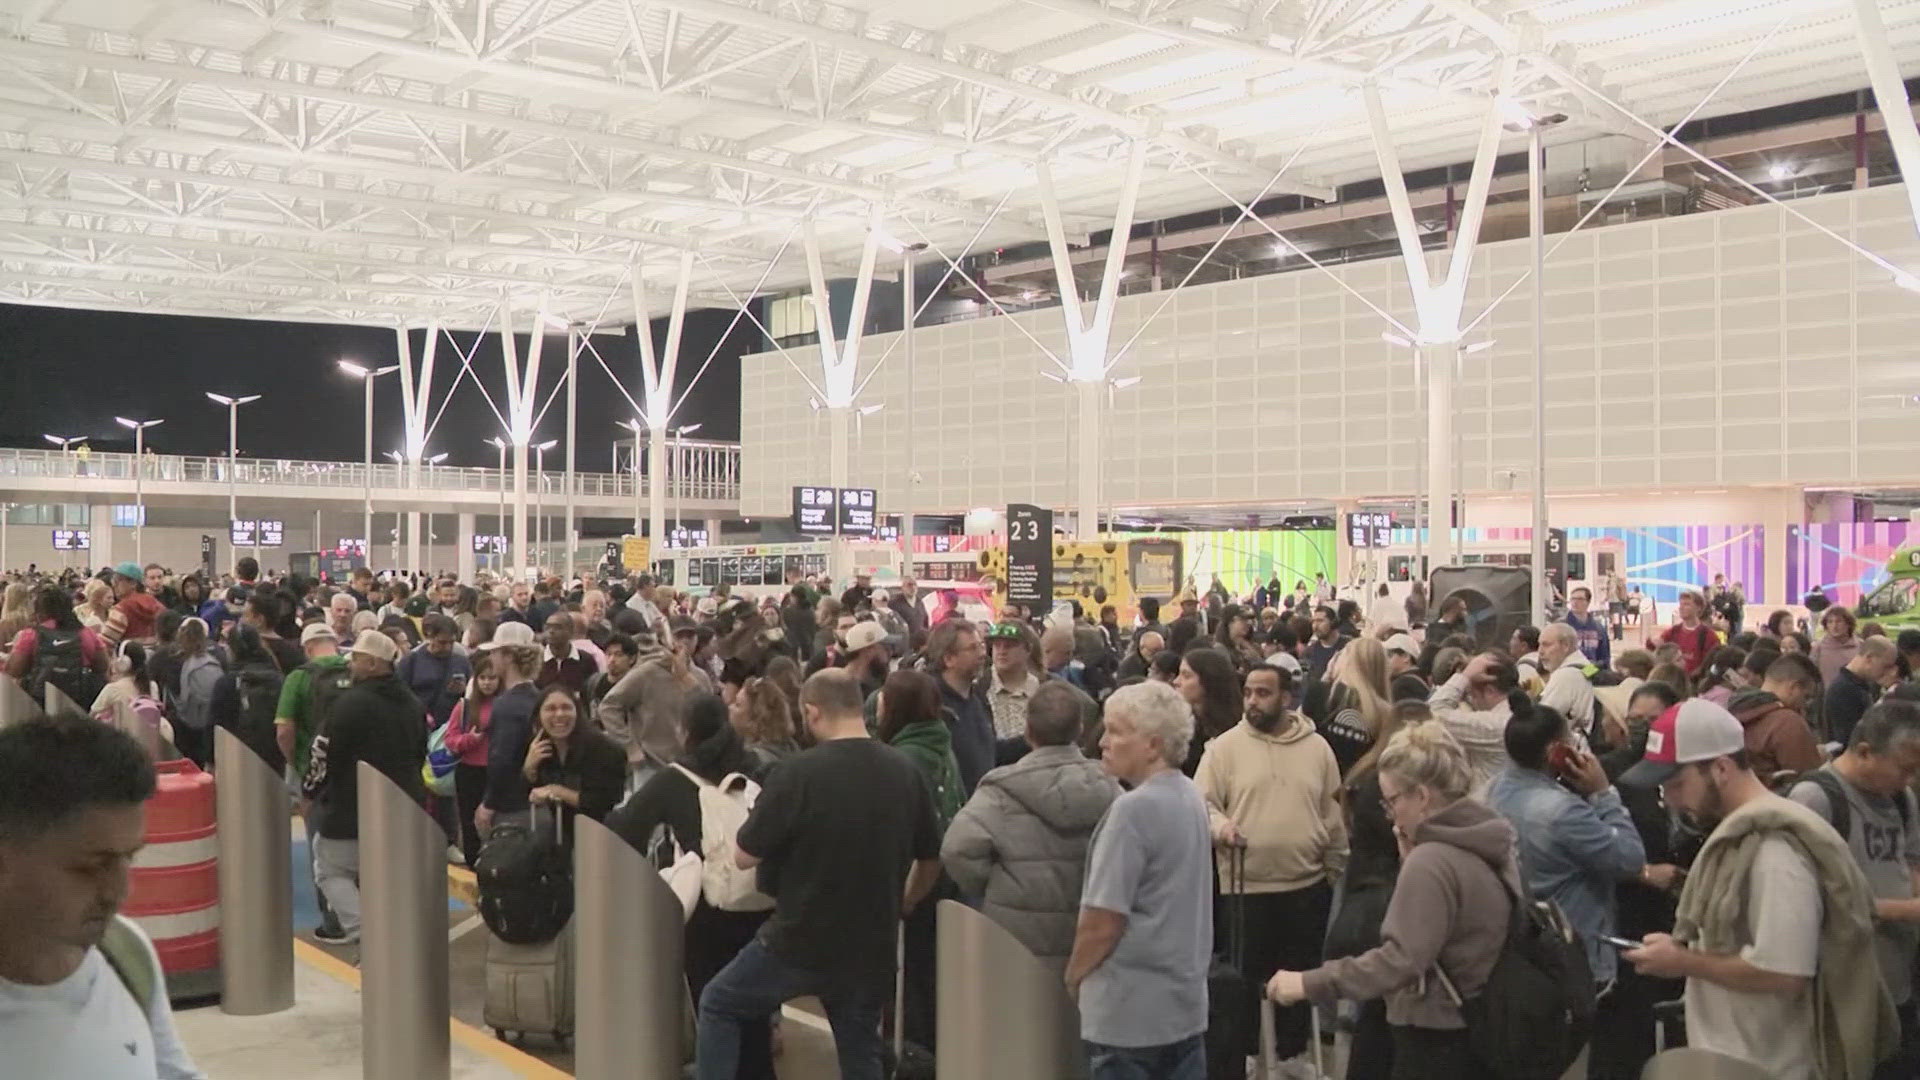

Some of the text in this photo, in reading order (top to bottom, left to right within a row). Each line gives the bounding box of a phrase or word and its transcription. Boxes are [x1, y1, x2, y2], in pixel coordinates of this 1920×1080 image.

[1011, 521, 1038, 540] 2 3
[1549, 538, 1559, 553] 5
